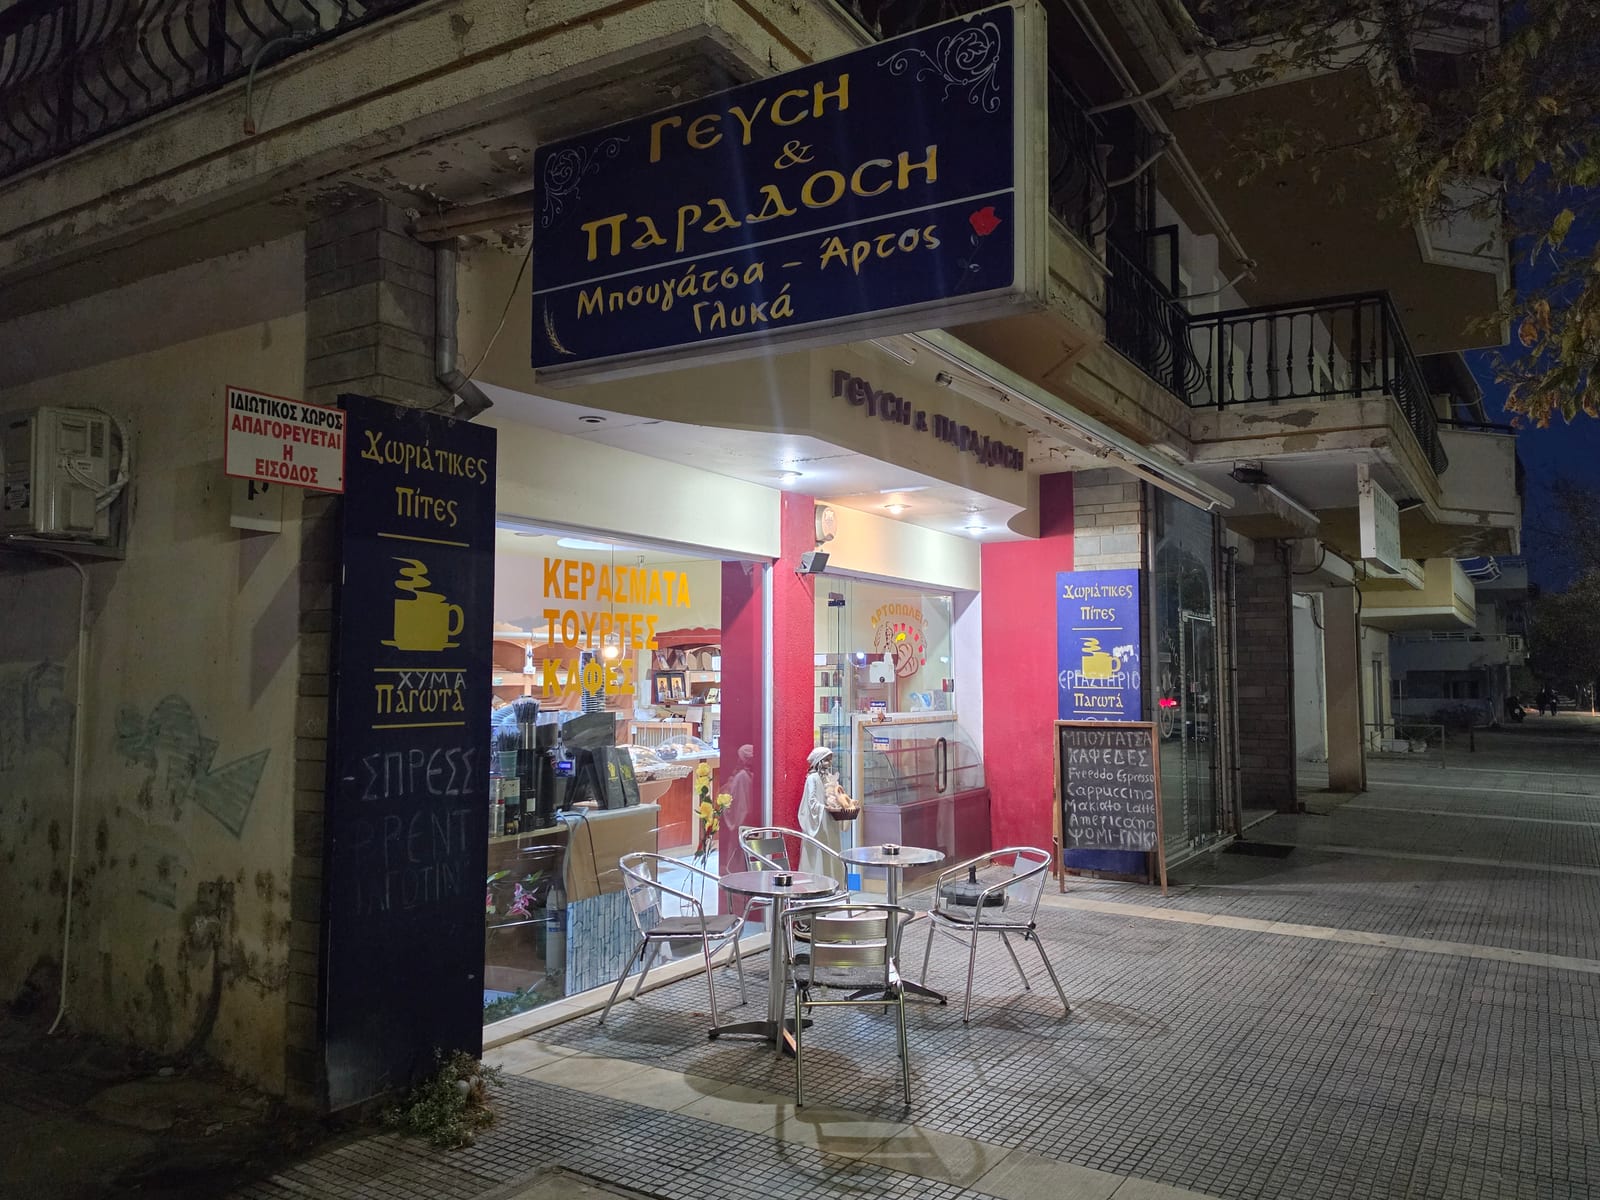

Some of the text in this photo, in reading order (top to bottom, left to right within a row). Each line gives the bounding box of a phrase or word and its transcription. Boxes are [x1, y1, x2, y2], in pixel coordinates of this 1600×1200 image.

[774, 139, 815, 170] &
[576, 260, 766, 320] Μπουγάτσα
[693, 283, 795, 333] Γλυκά
[230, 391, 343, 430] ΙΔΙΩΤΙΚΟΣ ΧΩΡΟΣ
[231, 414, 341, 449] ΑΠΑΓΟΡΕΥΕΤΑΙ
[255, 458, 319, 484] ΕΙΣΟΔΟΣ
[543, 557, 692, 609] ΚΕΡΑΣΜΑΤΑ
[543, 608, 660, 650] ΤΟΥΡΤΕΣ
[542, 657, 636, 697] ΚΑΦΕΣ
[1062, 731, 1152, 748] ΜΠΟΥΓΑΤΣΑ
